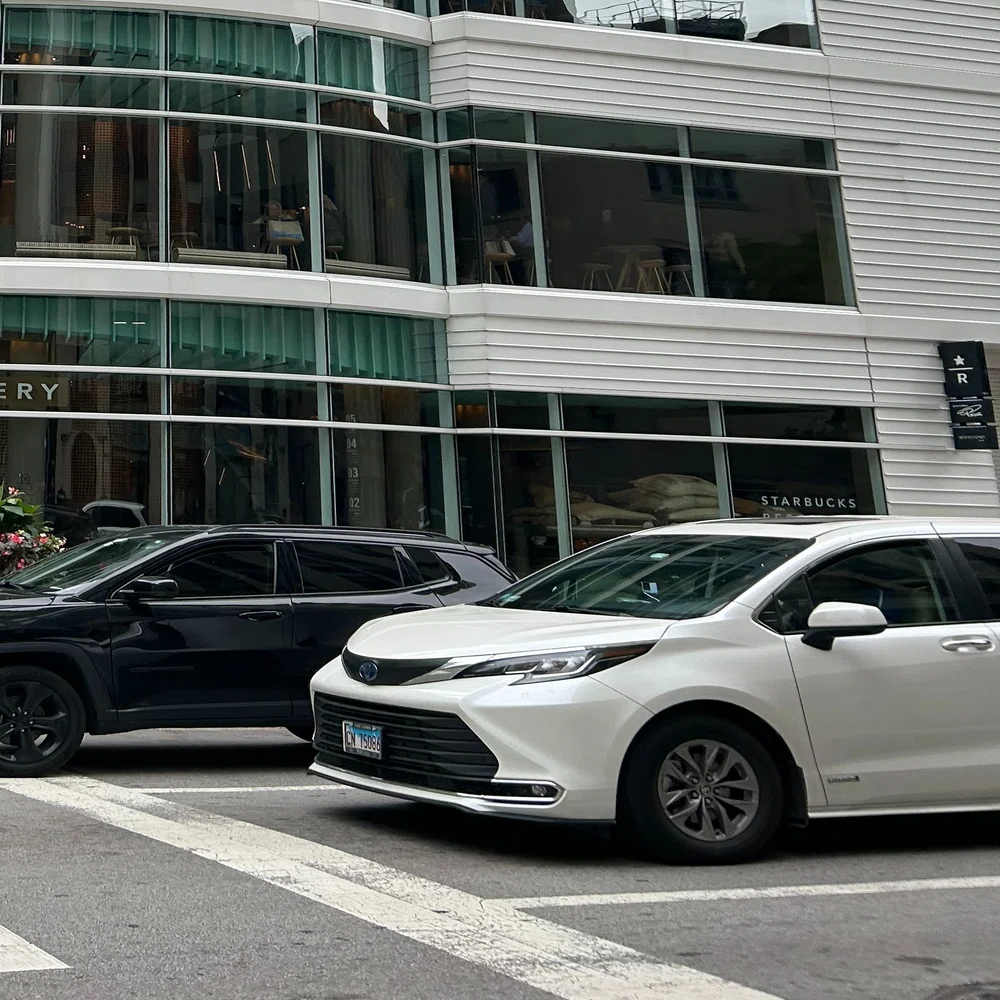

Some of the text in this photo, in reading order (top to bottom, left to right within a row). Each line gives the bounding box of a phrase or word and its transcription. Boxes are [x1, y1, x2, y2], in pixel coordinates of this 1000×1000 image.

[956, 372, 969, 384] R
[348, 467, 359, 478] 03
[349, 497, 360, 508] 02
[760, 495, 857, 509] STARBUCKS
